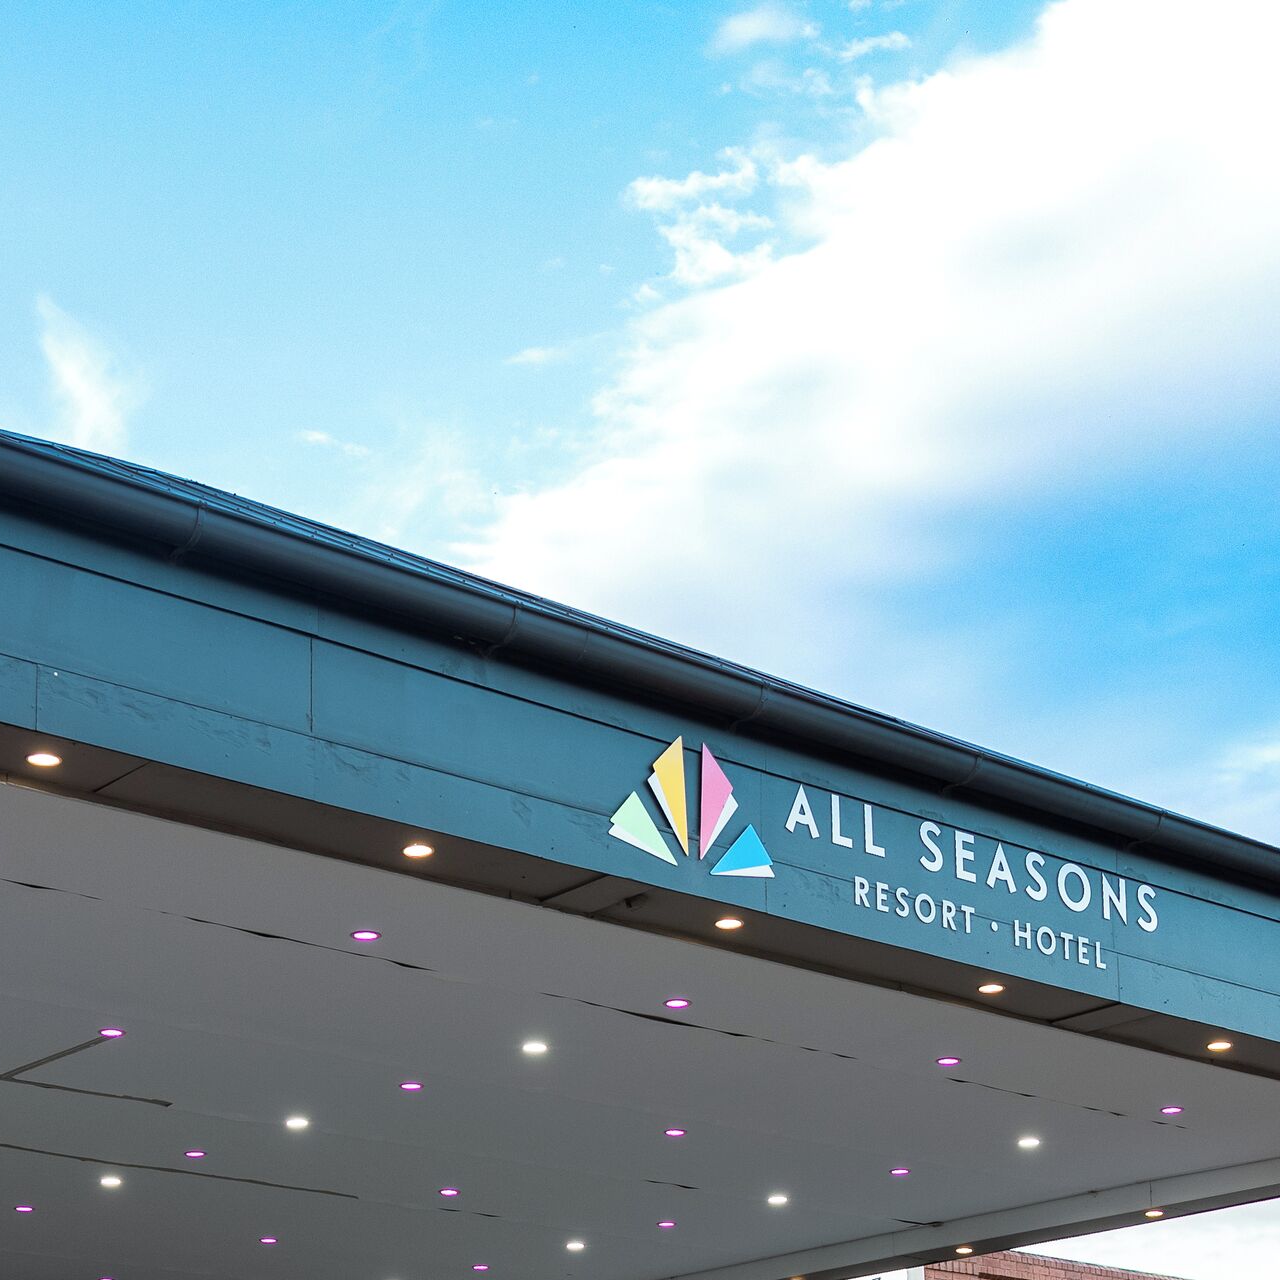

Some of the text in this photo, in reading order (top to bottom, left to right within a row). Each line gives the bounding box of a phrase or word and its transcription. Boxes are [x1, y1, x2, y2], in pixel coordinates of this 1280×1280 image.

[784, 783, 1160, 933] ALL SEASONS
[853, 875, 1108, 970] RESORT HOTEL
